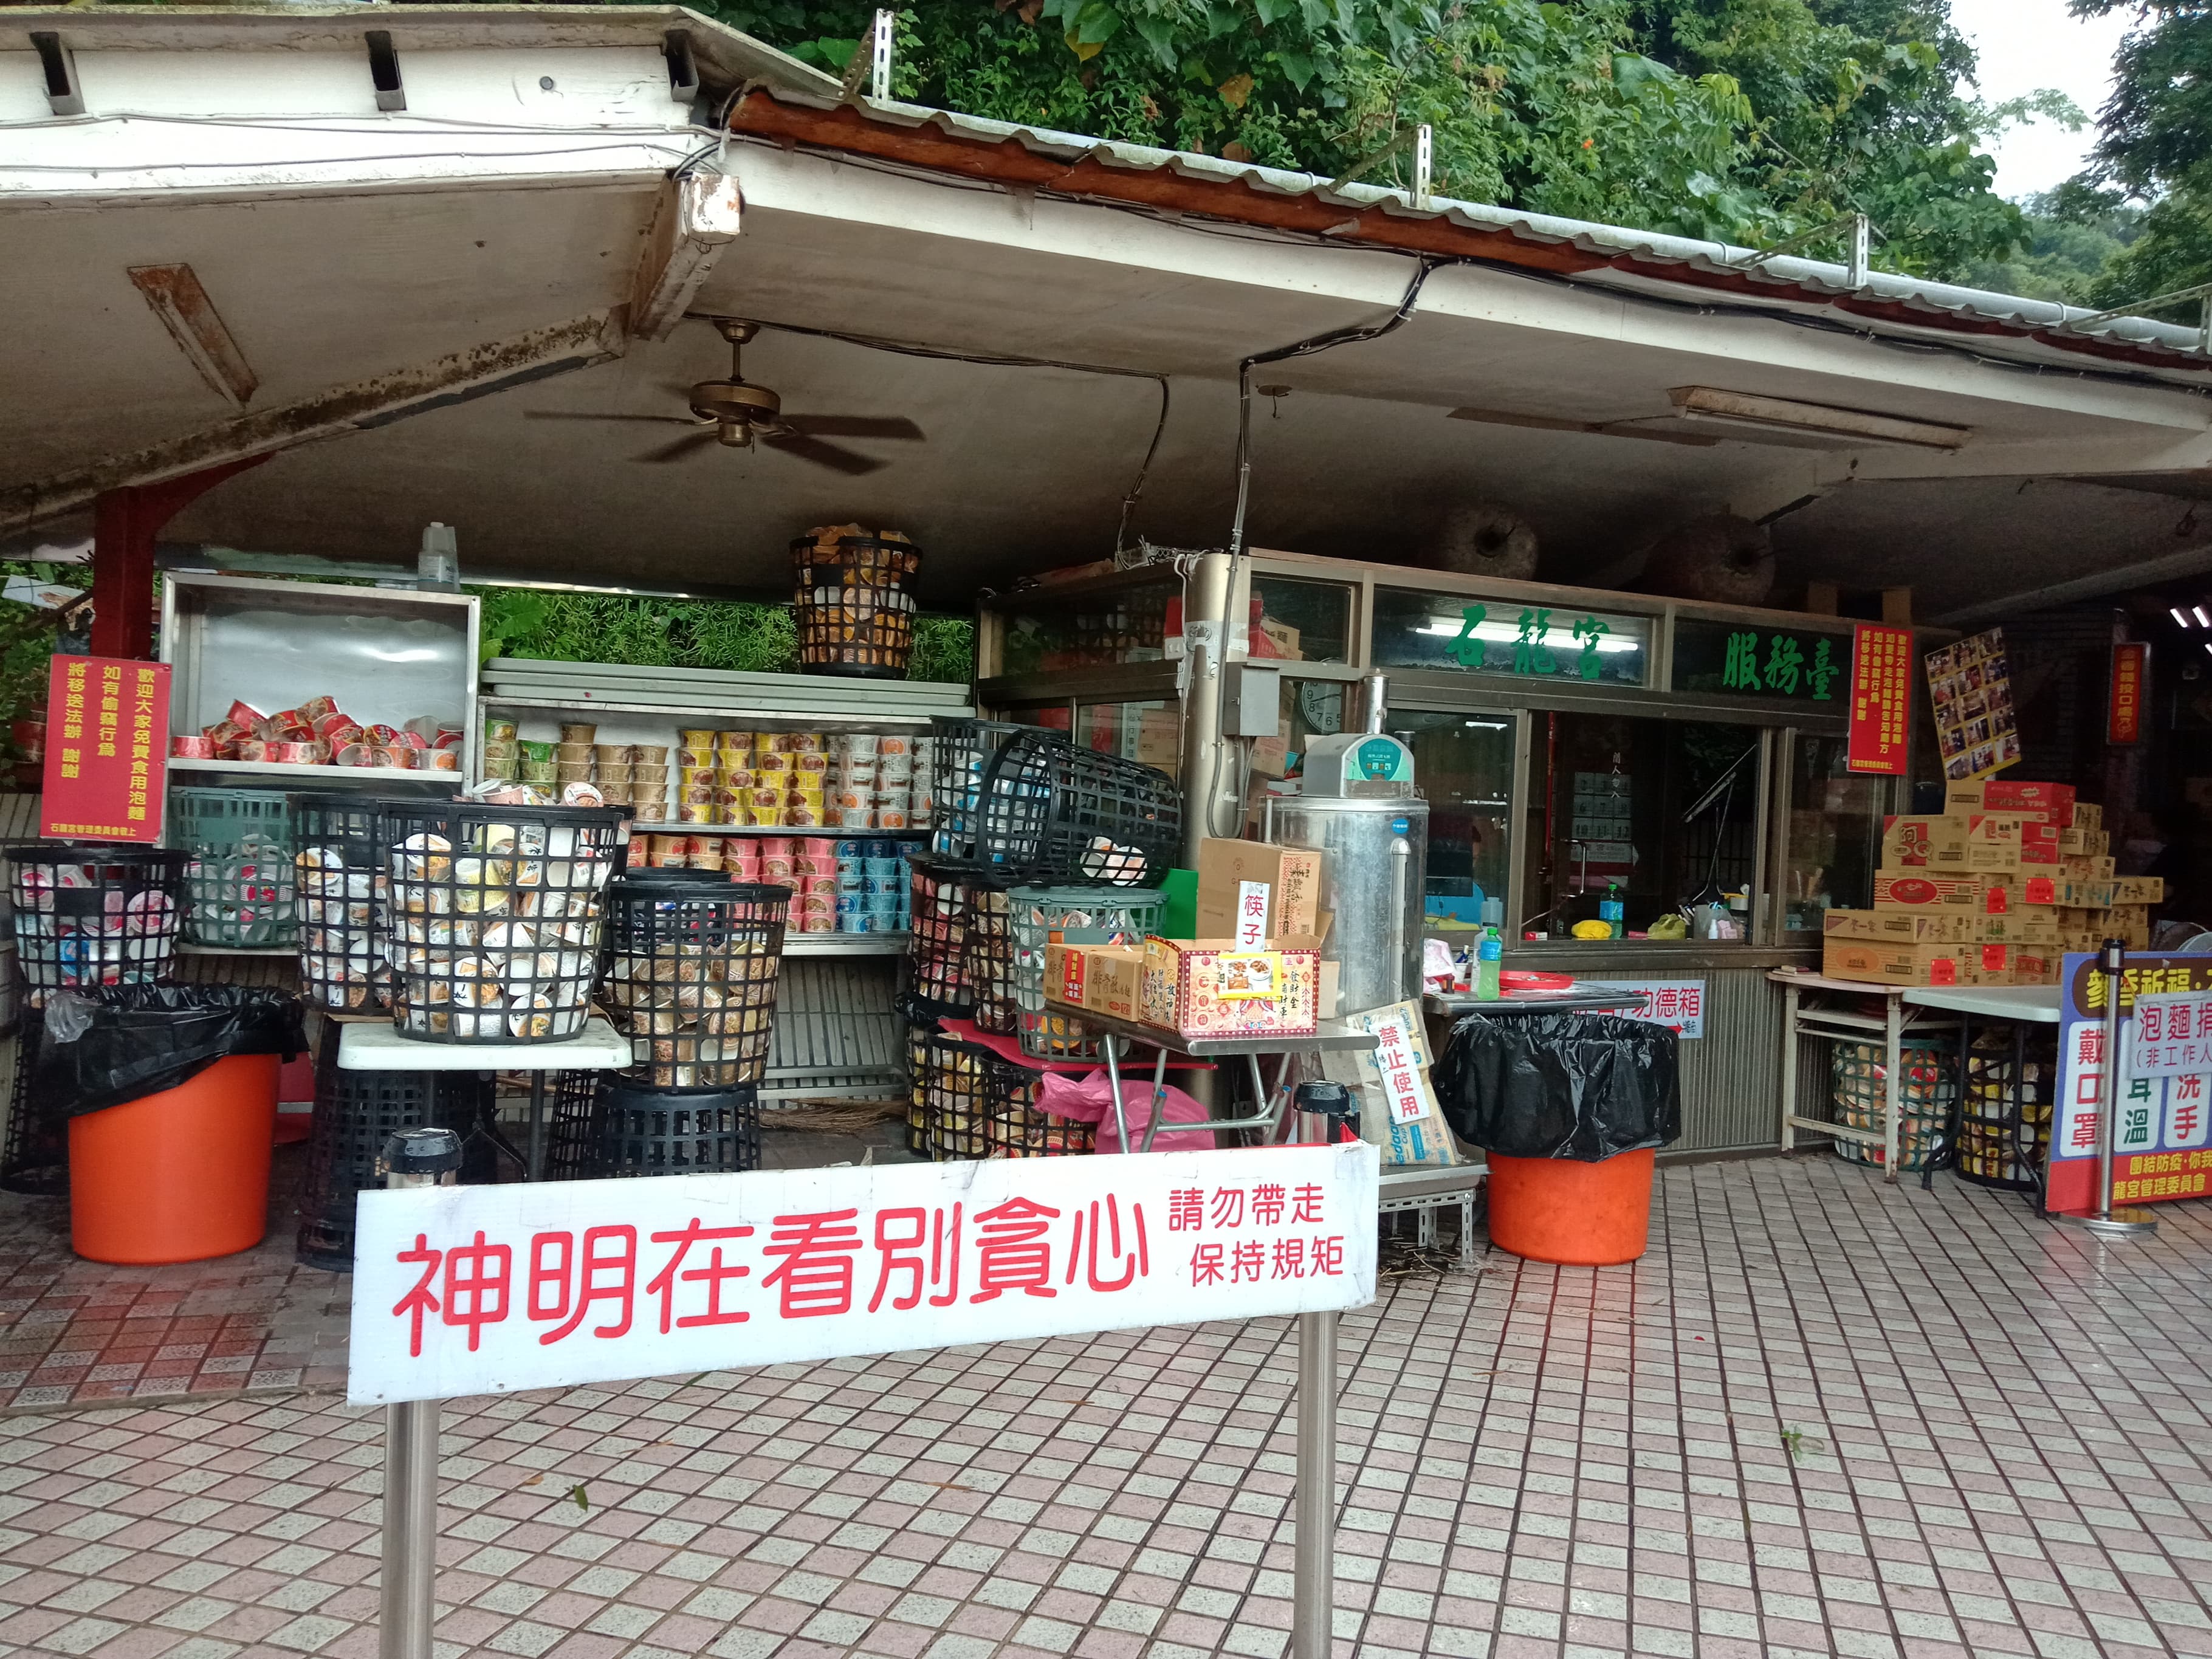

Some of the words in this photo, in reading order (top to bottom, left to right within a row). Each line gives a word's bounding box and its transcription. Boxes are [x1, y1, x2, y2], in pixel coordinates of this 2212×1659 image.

[1445, 604, 1610, 679] 石龍宮
[1723, 632, 1839, 701] 服務臺
[63, 662, 86, 739] 將移送法辦
[1307, 690, 1313, 699] 9
[1308, 702, 1315, 712] 8
[1317, 712, 1323, 721] 7
[128, 668, 155, 820] 歡迎大家免費食用泡麵
[1326, 716, 1332, 726] 6
[61, 748, 80, 778] 謝謝
[1243, 894, 1264, 944] 筷子
[1379, 1025, 1420, 1118] 禁止使用
[2071, 1028, 2107, 1149] 戴口罩
[1169, 1184, 1325, 1232] 請勿帶走
[392, 1193, 1149, 1358] 神明在看別貪心
[1189, 1235, 1345, 1286] 保持規矩
